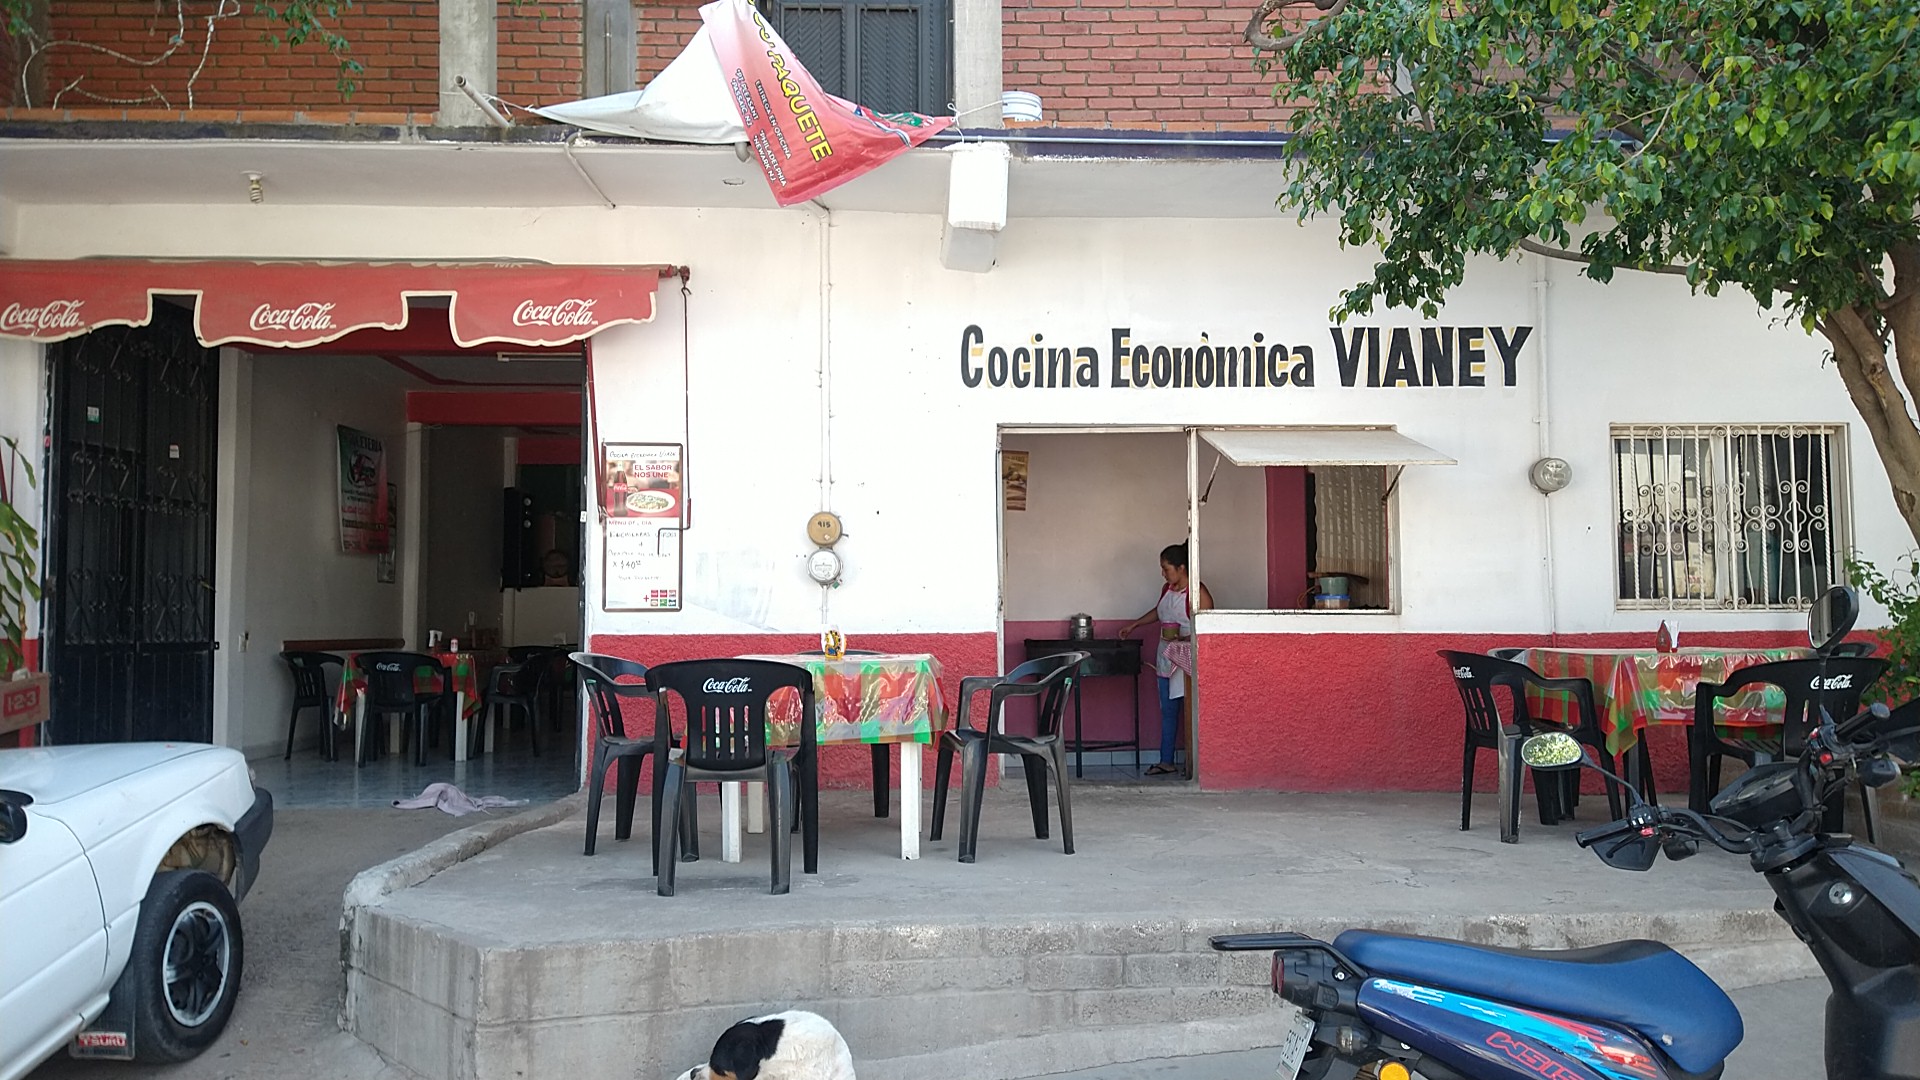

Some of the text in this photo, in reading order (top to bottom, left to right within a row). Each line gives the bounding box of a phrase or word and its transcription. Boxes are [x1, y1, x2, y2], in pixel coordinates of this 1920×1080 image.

[768, 113, 779, 127] EN
[774, 126, 792, 160] OFICINA
[0, 300, 85, 330] Coca-Cola
[250, 302, 336, 331] Coca-Cola
[512, 298, 598, 327] Coca-Cola
[961, 324, 1100, 389] Cocina
[1329, 327, 1534, 388] VIANEY
[817, 520, 832, 528] 915
[702, 677, 751, 693] Coca-Cola
